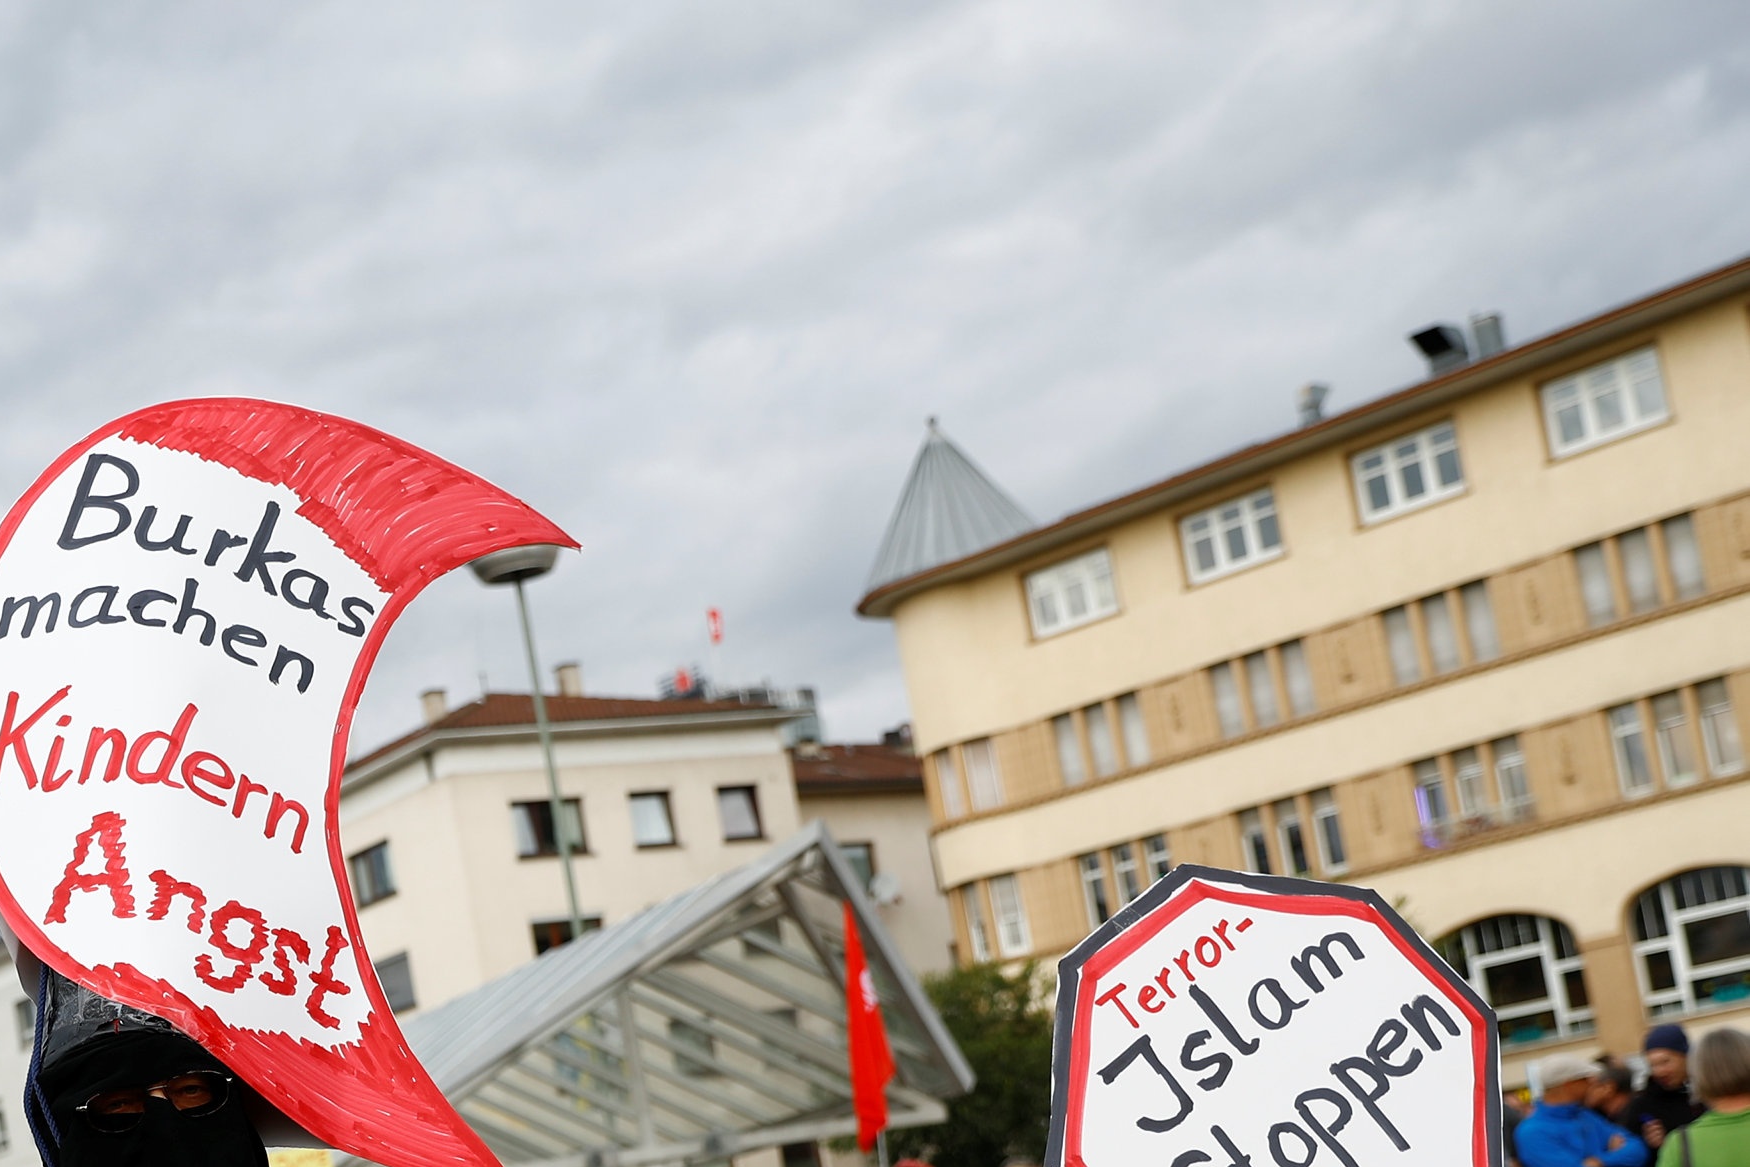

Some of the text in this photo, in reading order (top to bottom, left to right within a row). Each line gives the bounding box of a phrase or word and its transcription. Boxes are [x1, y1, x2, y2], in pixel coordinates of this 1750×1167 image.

[57, 454, 374, 637] Burkas
[44, 812, 351, 1029] Angst
[1095, 917, 1253, 1029] Terror-
